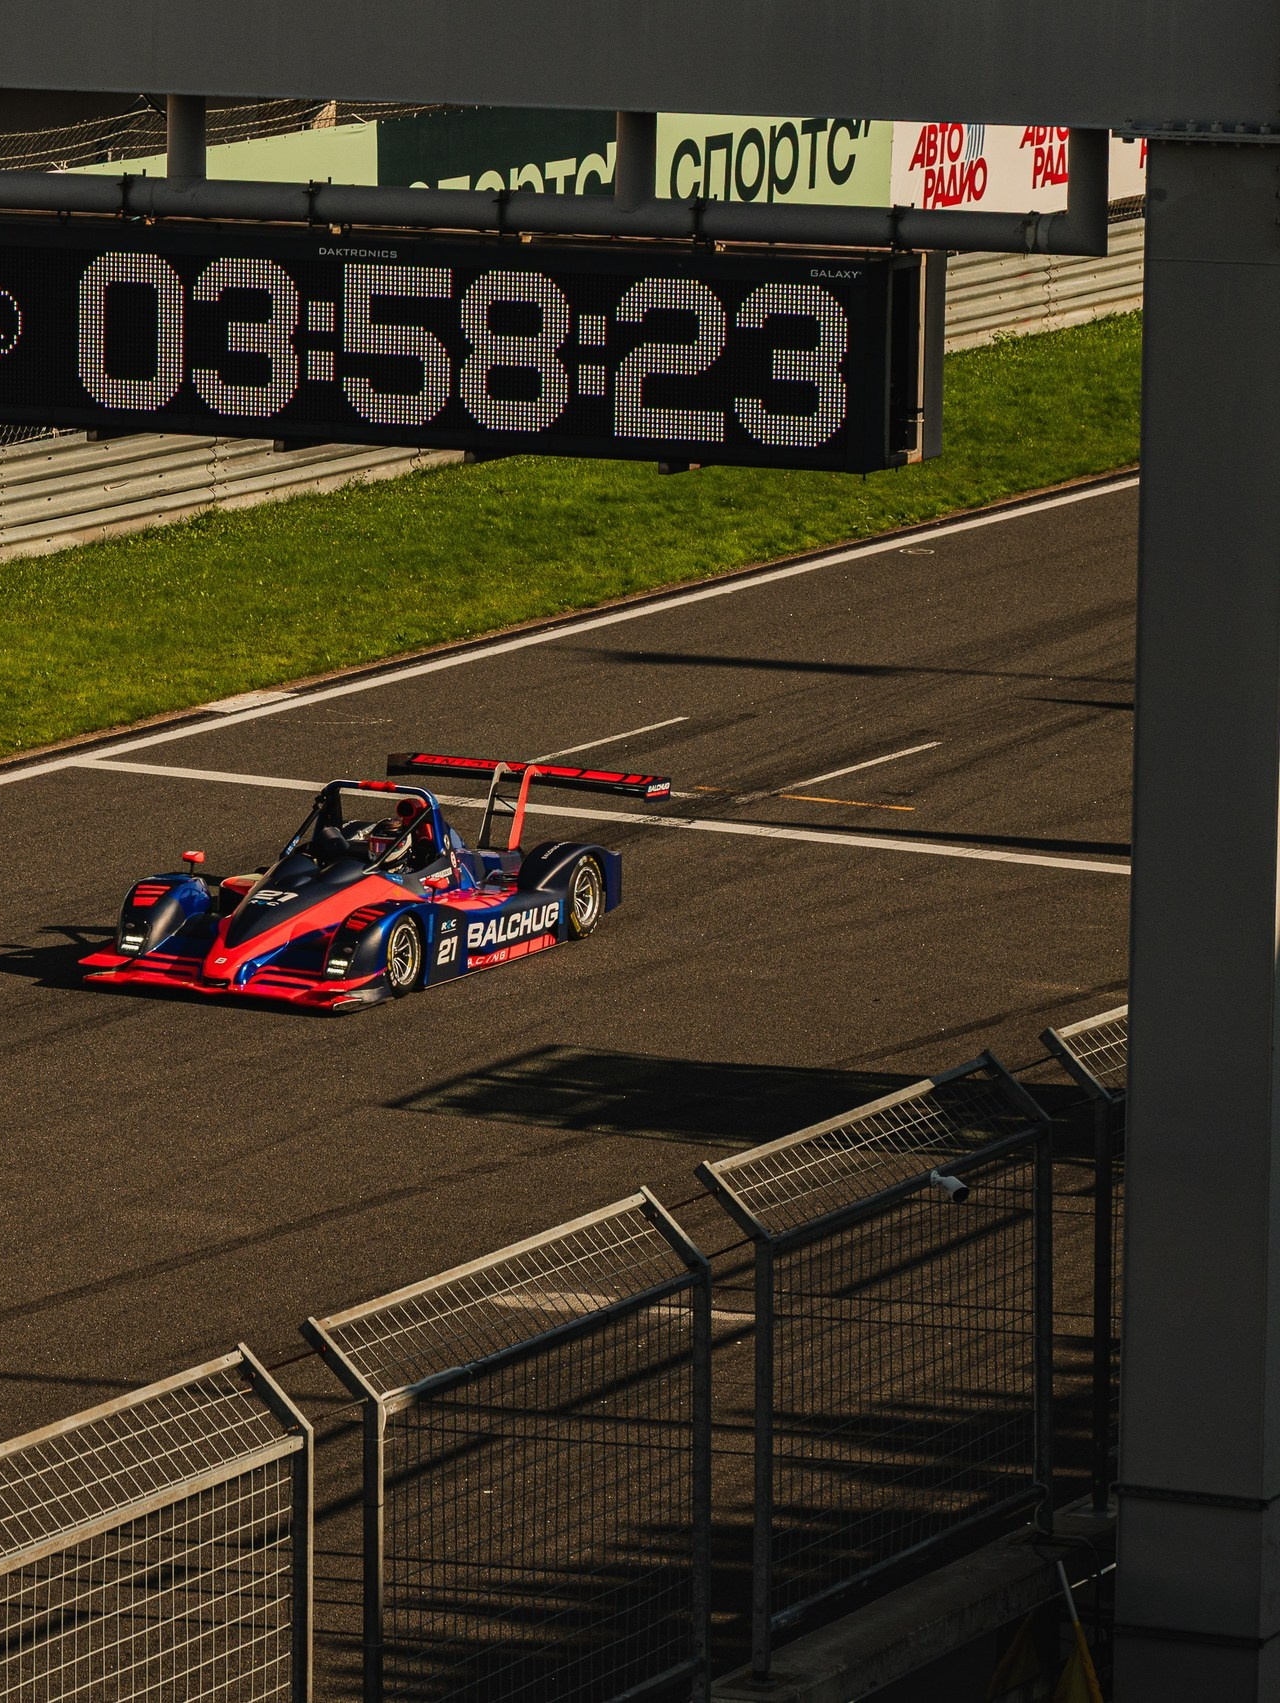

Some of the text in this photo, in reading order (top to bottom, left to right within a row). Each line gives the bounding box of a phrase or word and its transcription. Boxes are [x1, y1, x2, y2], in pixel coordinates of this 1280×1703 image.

[923, 157, 988, 209] РАДИО
[1032, 144, 1069, 189] РАД
[318, 247, 398, 259] DAKTRONICS
[77, 251, 849, 447] 03:58:23
[251, 890, 299, 903] 21
[467, 903, 559, 949] BALCHUG
[436, 936, 458, 966] 21
[467, 951, 506, 968] ACING
